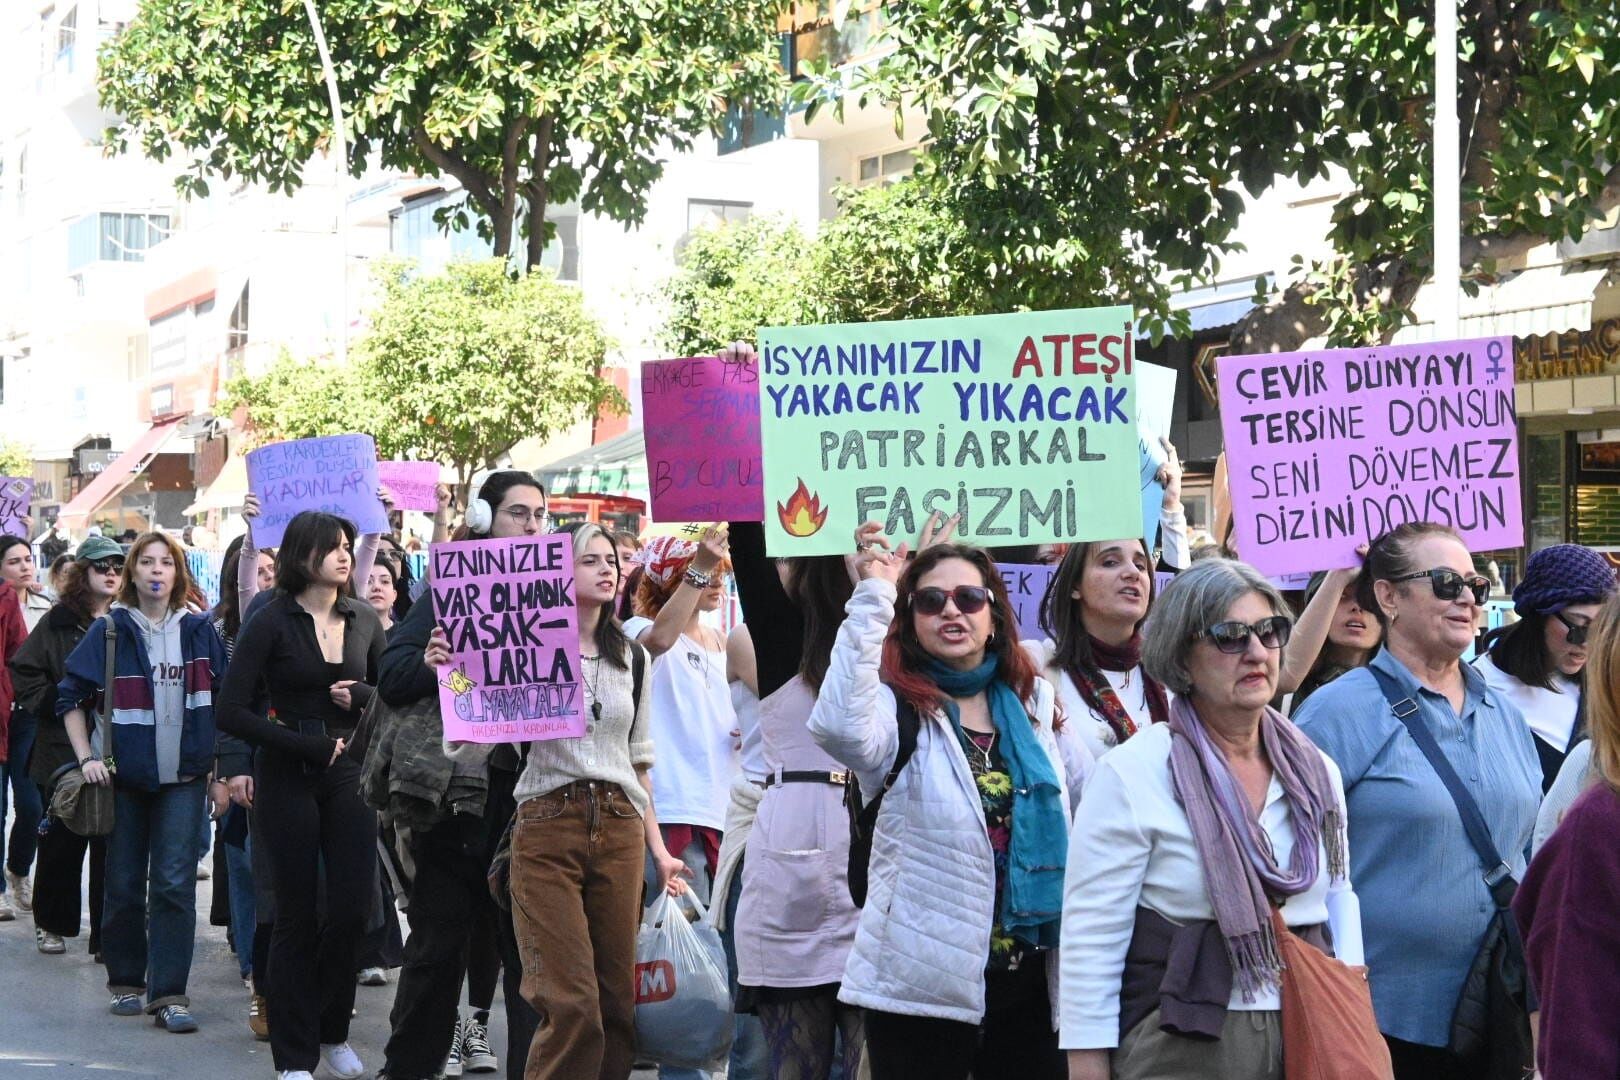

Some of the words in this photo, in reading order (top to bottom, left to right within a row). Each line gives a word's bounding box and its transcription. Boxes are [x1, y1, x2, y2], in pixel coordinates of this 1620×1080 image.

[765, 339, 981, 376] İSYANIMIZIN
[1012, 321, 1133, 383] ATEŞİ
[1236, 358, 1327, 404] ÇEVİR
[1345, 352, 1472, 393] DÜNYAYI
[767, 382, 924, 418] YAKACAK
[954, 382, 1129, 424] YIKACAK
[1241, 405, 1365, 446] TERSİNE
[1389, 379, 1517, 436] DÖNSÜN
[820, 423, 1106, 471] PATRİARKAL
[1251, 453, 1320, 499] SENİ
[1349, 438, 1514, 490] DÖVEMEZ
[263, 471, 370, 503] KADINLAR
[1256, 495, 1355, 545] DİZİNİ
[1363, 483, 1505, 542] DÖVSÜN
[434, 542, 563, 579] İZNİNİZLE
[433, 583, 484, 618] VAR
[490, 577, 574, 614] OLMADIK
[482, 647, 574, 686] LARLA
[640, 967, 668, 996] M
